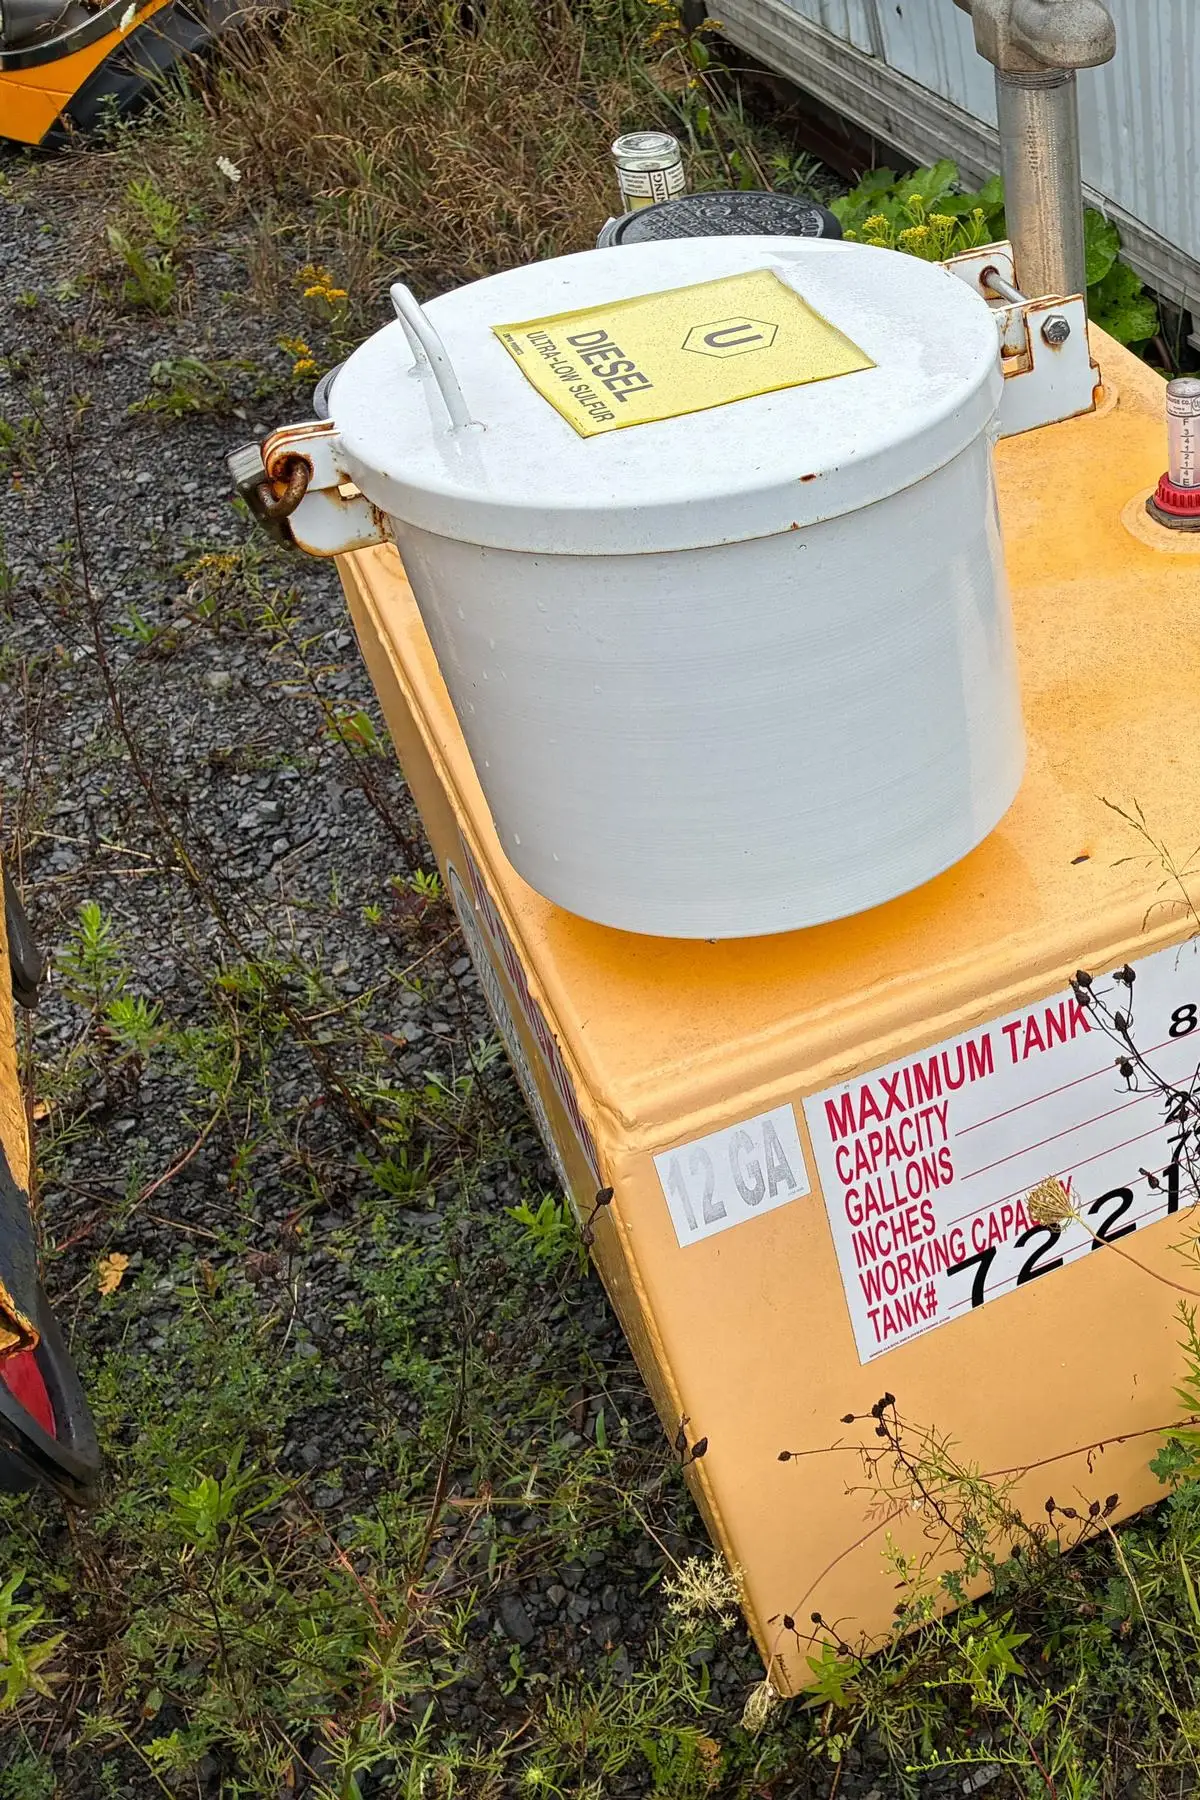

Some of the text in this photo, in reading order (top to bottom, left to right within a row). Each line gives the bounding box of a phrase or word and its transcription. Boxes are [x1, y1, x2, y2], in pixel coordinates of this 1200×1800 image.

[566, 329, 654, 403] DIESEL
[703, 323, 763, 347] U
[525, 331, 615, 423] ULTRA-LOW SULFUR
[1183, 478, 1190, 486] E
[825, 998, 1091, 1142] MAXIMUM TANK
[667, 1119, 797, 1232] 12 GA
[835, 1100, 949, 1186] CAPACITY
[844, 1147, 954, 1227] GALLONS
[852, 1199, 936, 1268] INCHES
[859, 1228, 965, 1307] WORKING
[971, 1175, 1073, 1254] CAPAY
[866, 1281, 938, 1343] TANK#
